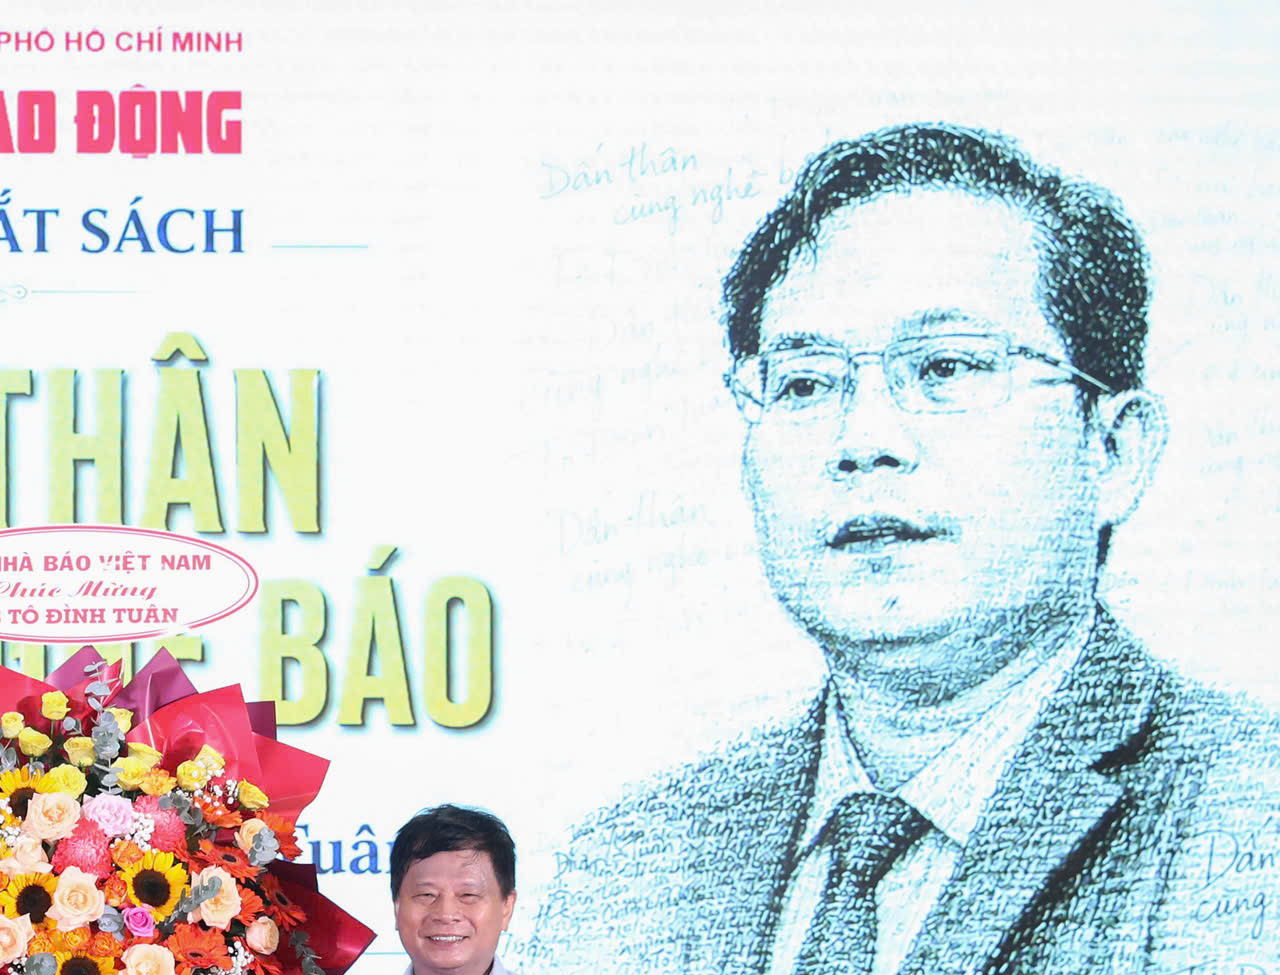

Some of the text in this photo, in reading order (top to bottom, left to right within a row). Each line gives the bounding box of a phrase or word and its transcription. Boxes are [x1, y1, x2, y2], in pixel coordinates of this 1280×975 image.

[115, 26, 163, 52] CHÍ
[172, 31, 243, 52] MINH
[73, 83, 243, 159] ĐỘNG
[80, 195, 246, 254] SÁCH
[43, 551, 91, 572] BÁO
[160, 554, 212, 571] NAM
[7, 604, 40, 625] TÔ
[45, 606, 106, 625] ĐÌNH
[113, 603, 179, 624] TUÂN
[259, 545, 497, 728] BÁO
